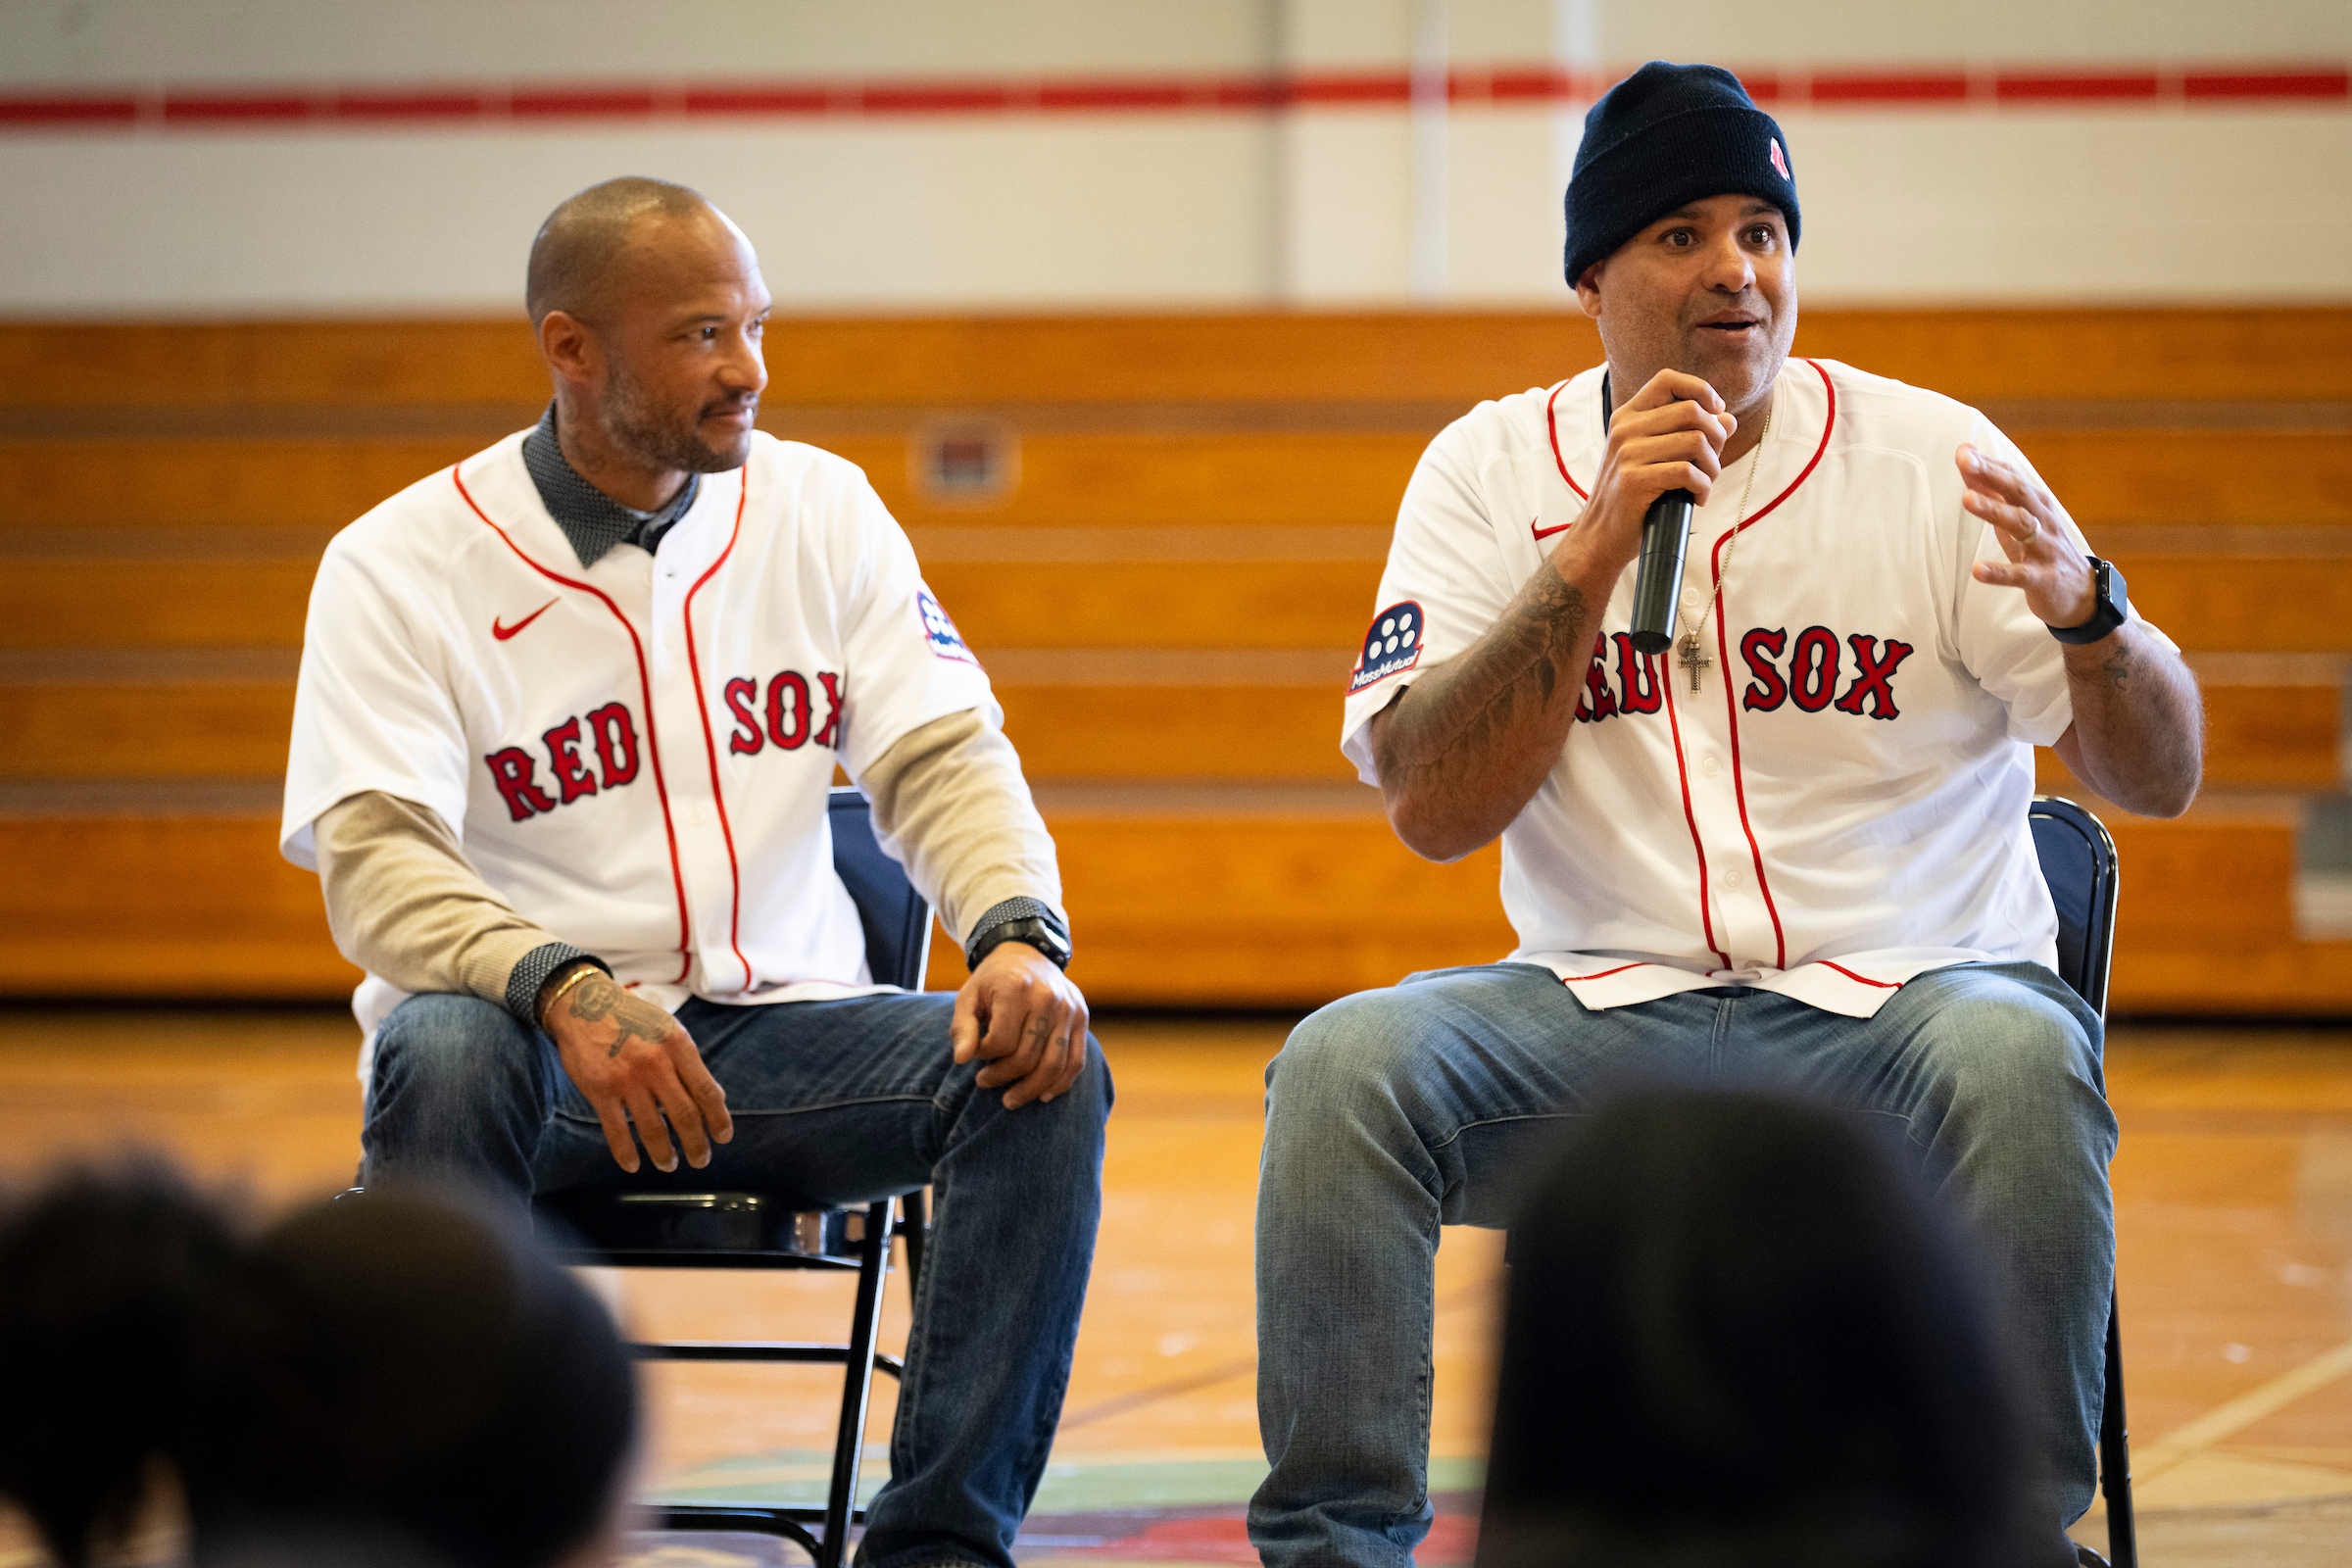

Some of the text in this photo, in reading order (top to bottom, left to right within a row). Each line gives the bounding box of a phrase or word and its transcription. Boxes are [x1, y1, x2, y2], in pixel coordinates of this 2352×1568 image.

[1350, 650, 1420, 690] MassMutual
[1574, 625, 1914, 723] ED SOX
[484, 702, 639, 822] RED
